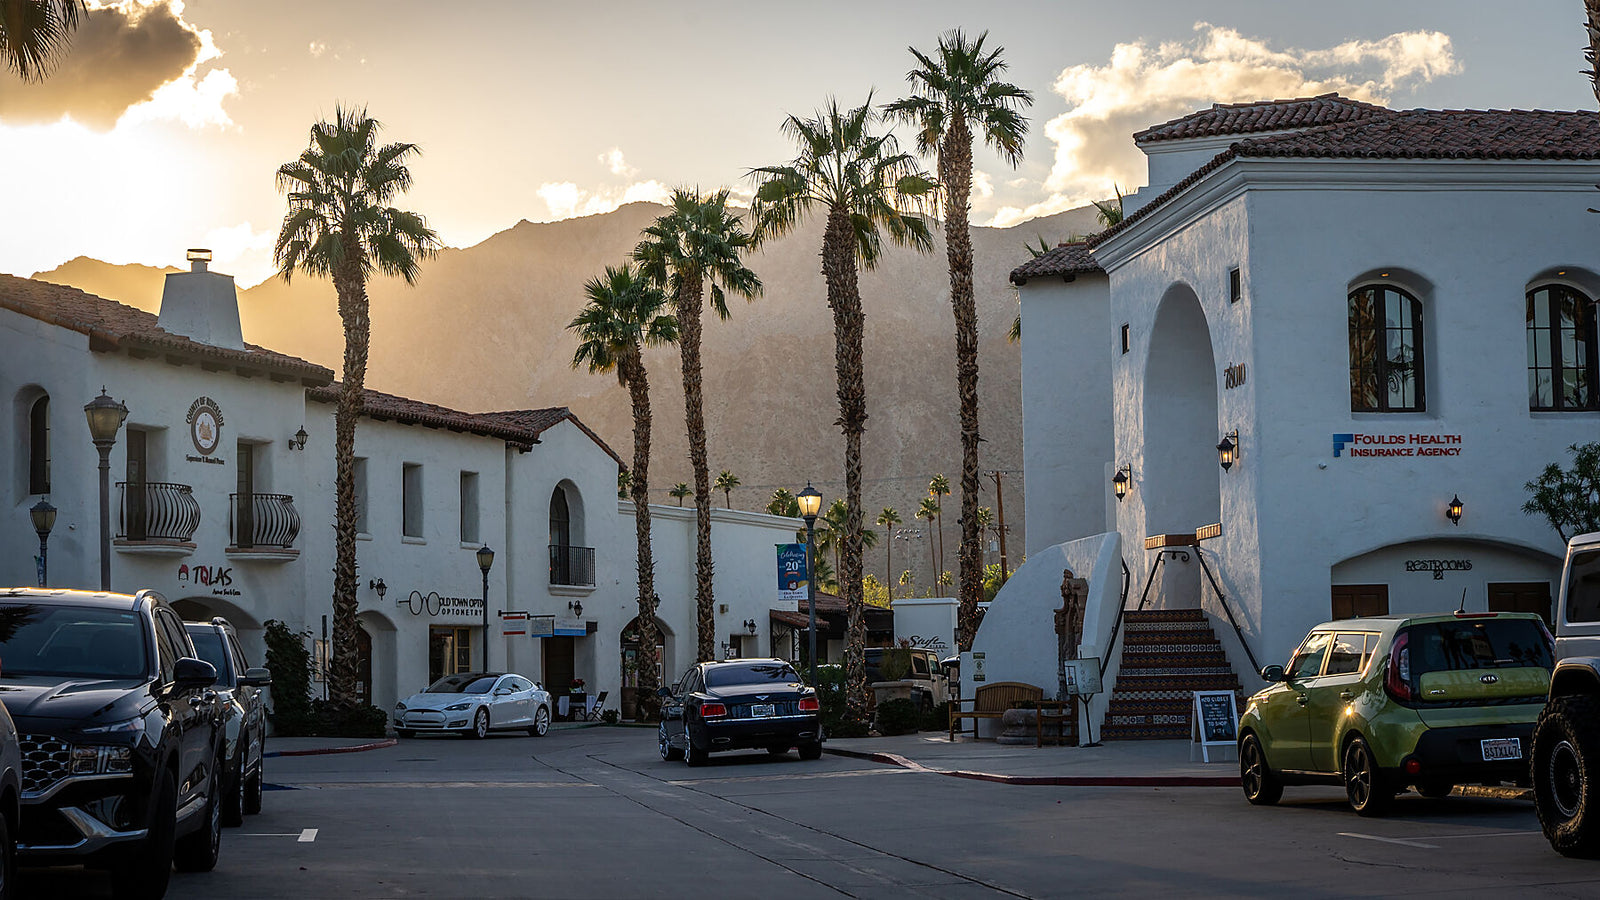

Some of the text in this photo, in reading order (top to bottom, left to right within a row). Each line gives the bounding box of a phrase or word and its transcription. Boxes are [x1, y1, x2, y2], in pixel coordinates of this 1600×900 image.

[1223, 361, 1247, 390] 78010
[185, 398, 200, 425] COUNTY
[206, 396, 225, 427] RIVERSIDE
[1405, 559, 1473, 571] RESTROOMS
[439, 597, 451, 607] OLD
[451, 598, 469, 609] TOWN
[441, 608, 483, 617] OPTOMETRY
